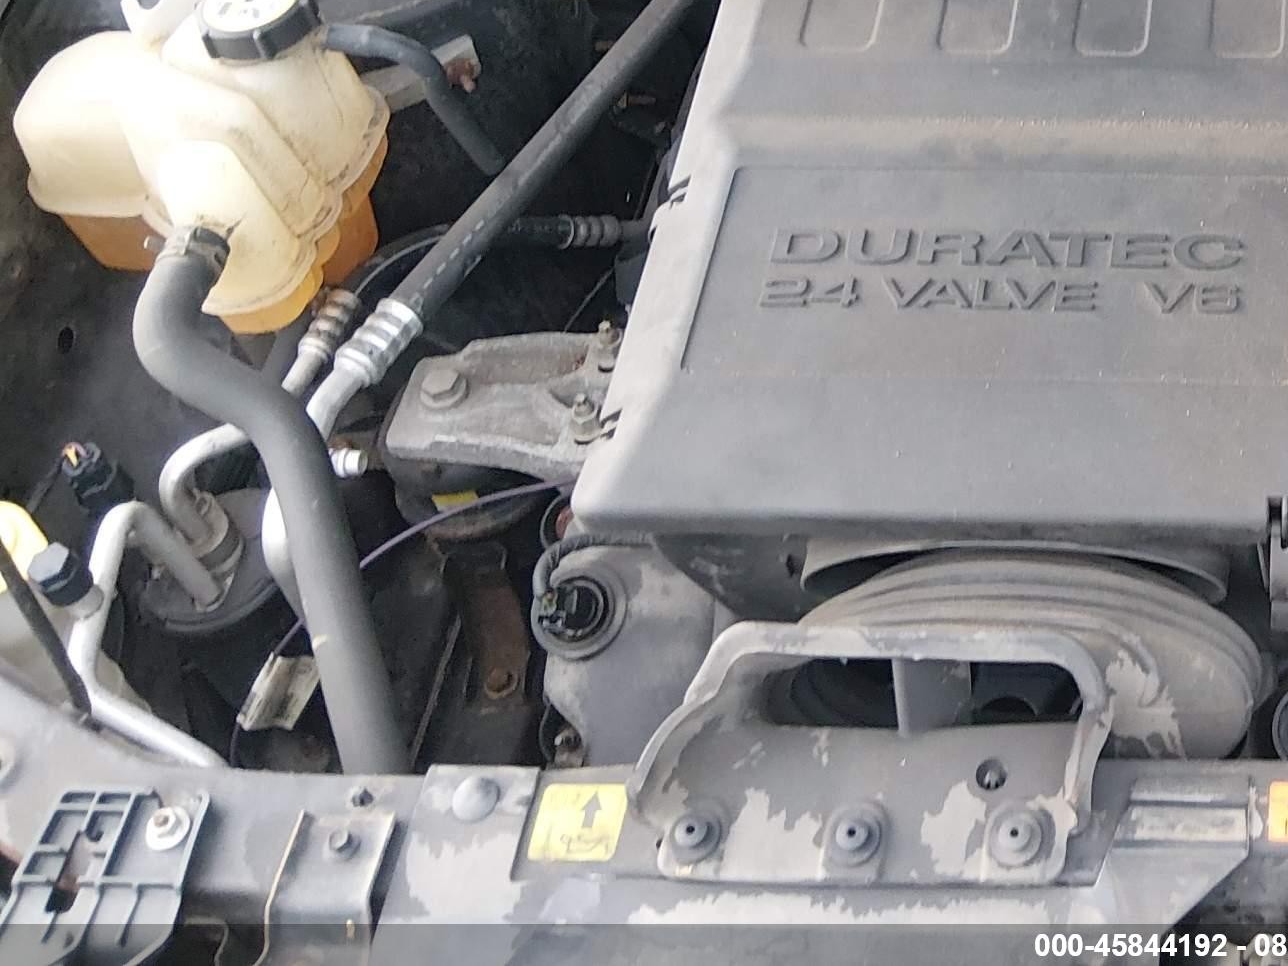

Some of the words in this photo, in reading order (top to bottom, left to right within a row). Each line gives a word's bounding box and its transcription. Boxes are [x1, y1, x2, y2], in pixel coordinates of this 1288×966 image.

[769, 228, 1246, 270] DURATEC
[759, 277, 860, 309] 24
[880, 277, 1098, 312] VALVE
[1143, 282, 1242, 315] V6
